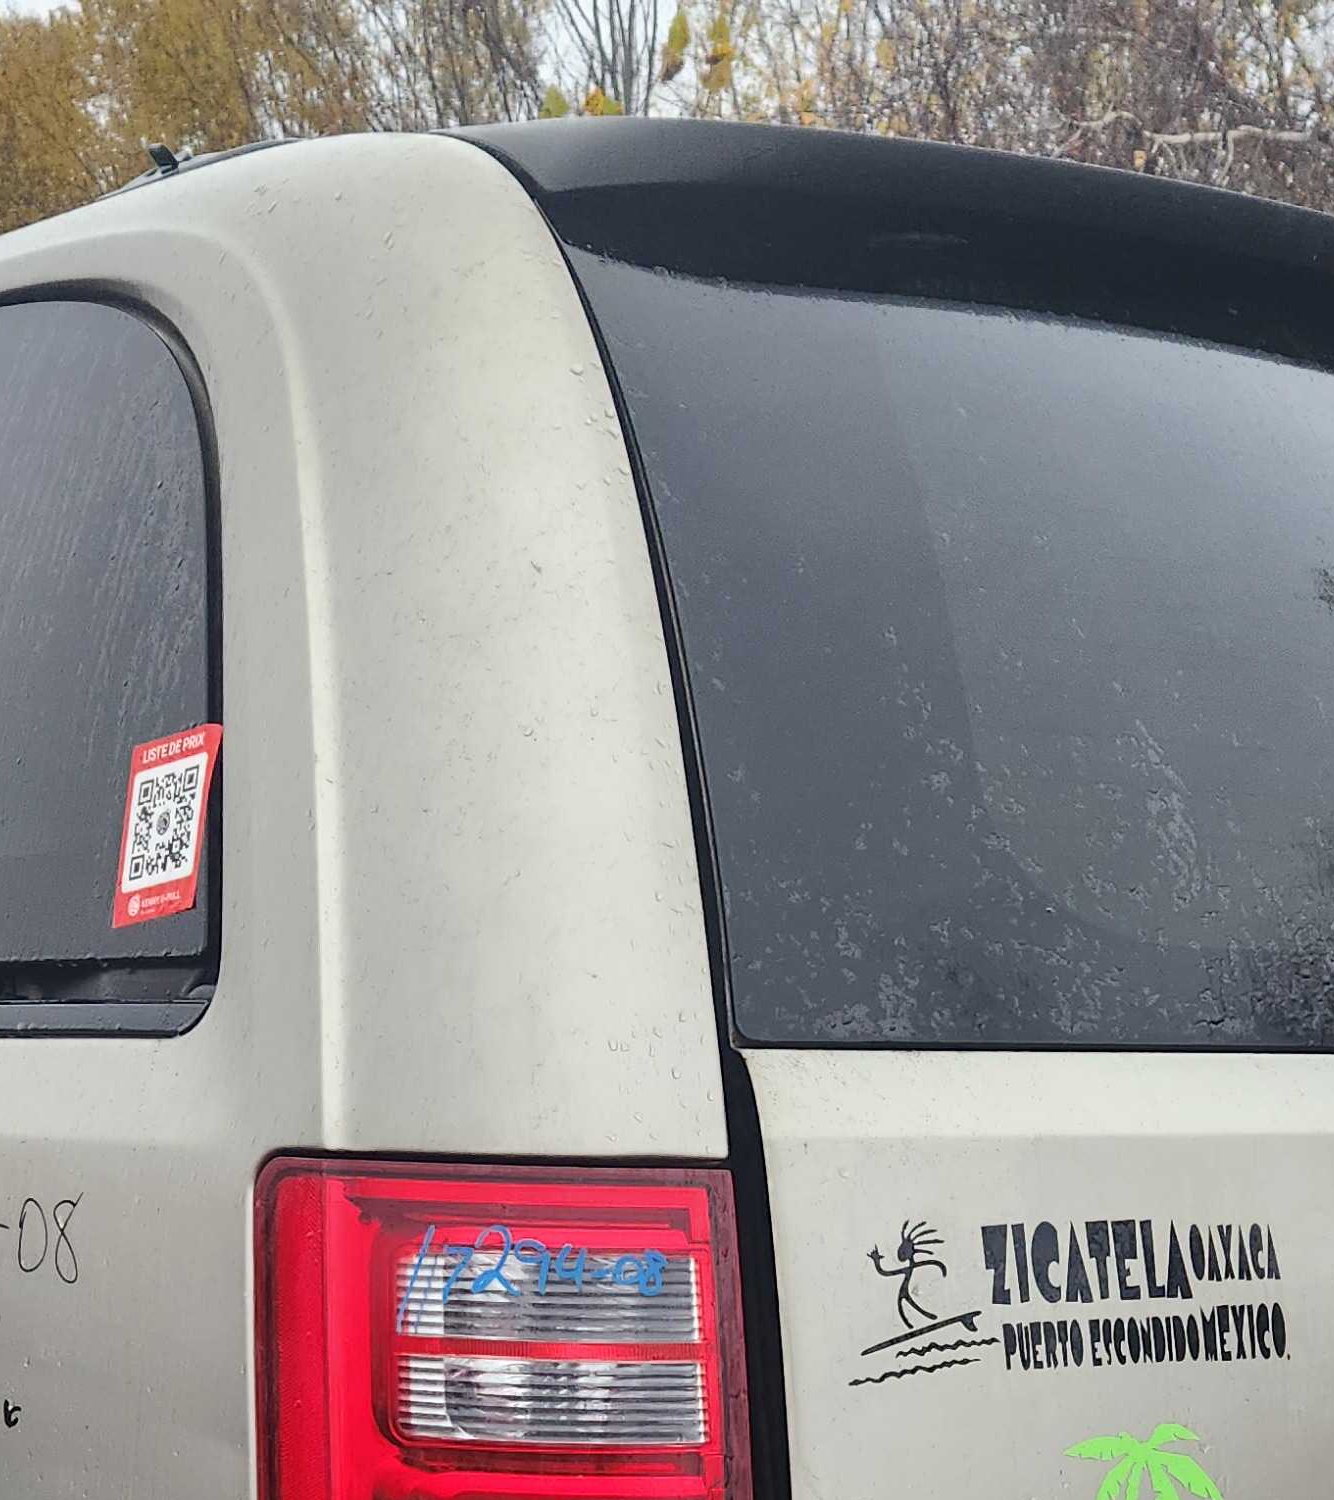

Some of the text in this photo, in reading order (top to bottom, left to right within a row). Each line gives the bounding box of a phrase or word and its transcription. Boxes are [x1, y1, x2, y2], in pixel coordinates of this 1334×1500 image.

[142, 731, 206, 764] LISTE DE PRIX
[397, 1224, 668, 1335] 17294-08
[981, 1219, 1282, 1305] ZICATELA OAXACA
[1002, 1319, 1084, 1370] PUERTO
[1089, 1312, 1200, 1367] ESCONDIDO
